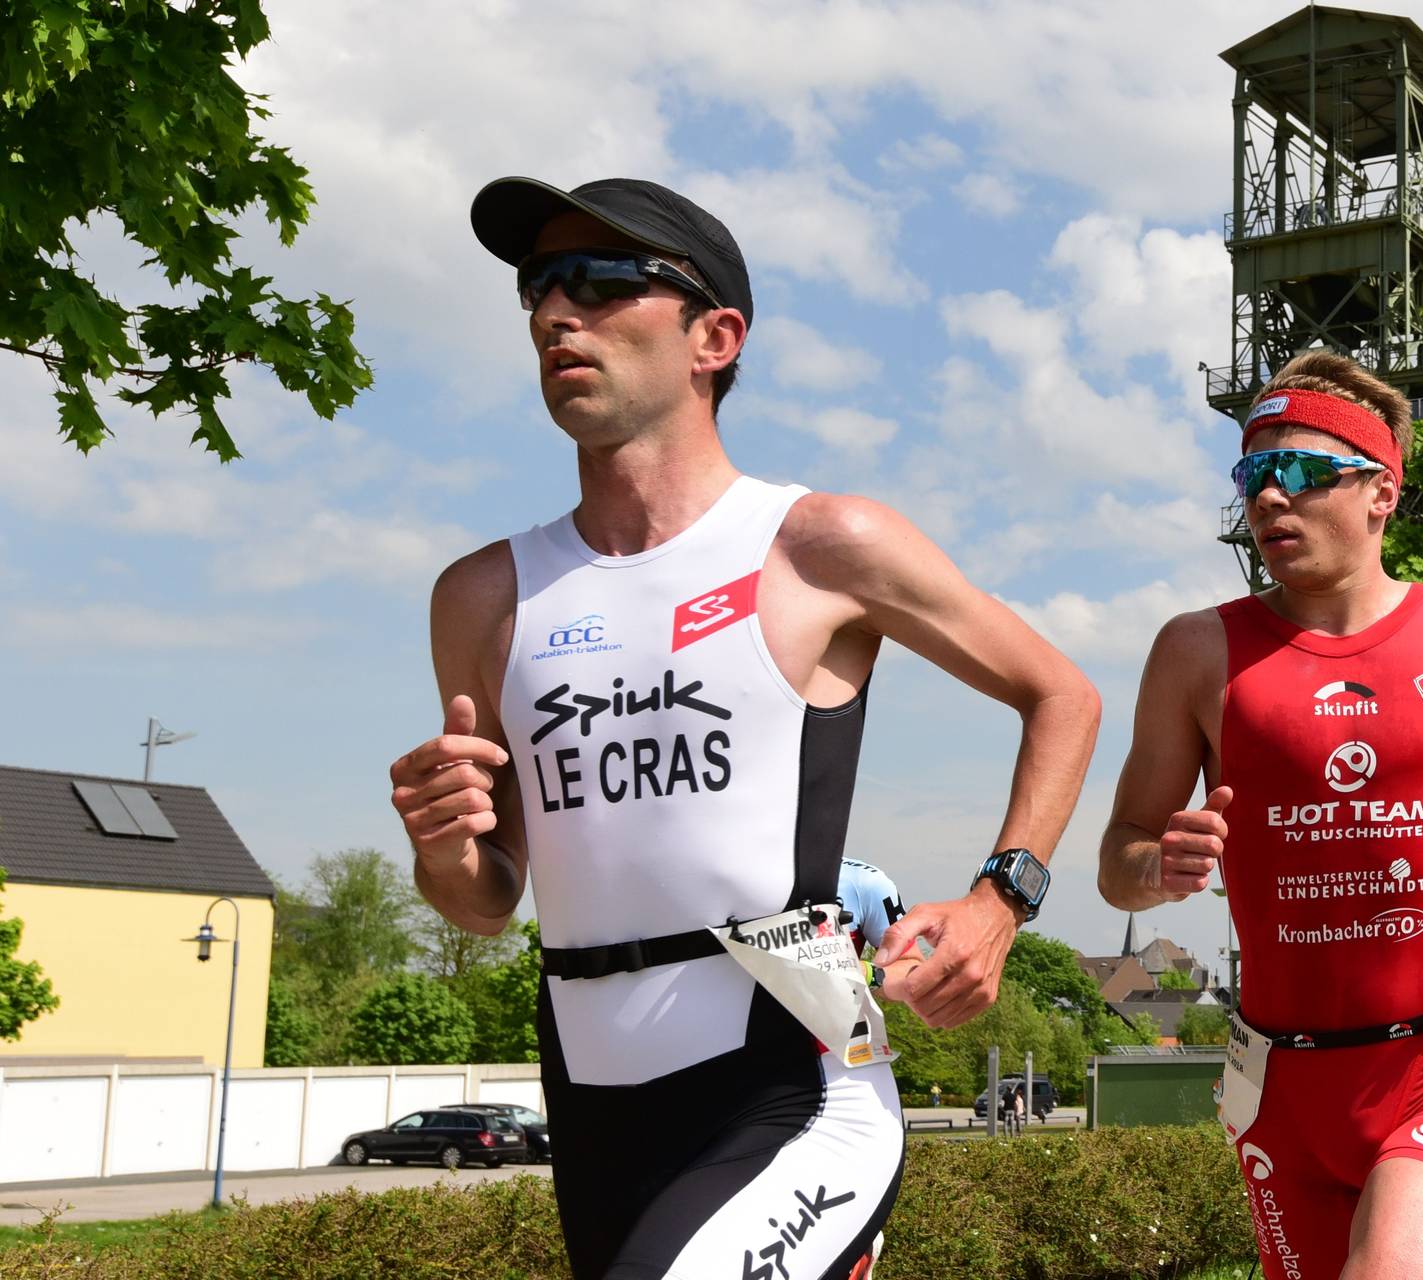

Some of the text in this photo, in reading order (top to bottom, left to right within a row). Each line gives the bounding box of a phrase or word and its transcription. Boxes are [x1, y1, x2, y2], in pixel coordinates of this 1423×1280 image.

[531, 643, 622, 661] natation-triathlon
[530, 669, 732, 745] Spiuk
[1314, 701, 1378, 716] skinfit
[534, 729, 731, 813] LE CRAS
[1267, 802, 1340, 827] EJOT
[1284, 831, 1304, 842] TV
[1277, 870, 1384, 886] UMWELTSERVICE
[743, 920, 813, 951] POWER
[1278, 920, 1381, 944] Krombacher
[1389, 1028, 1413, 1039] skinfit
[1294, 1040, 1315, 1048] skinfit
